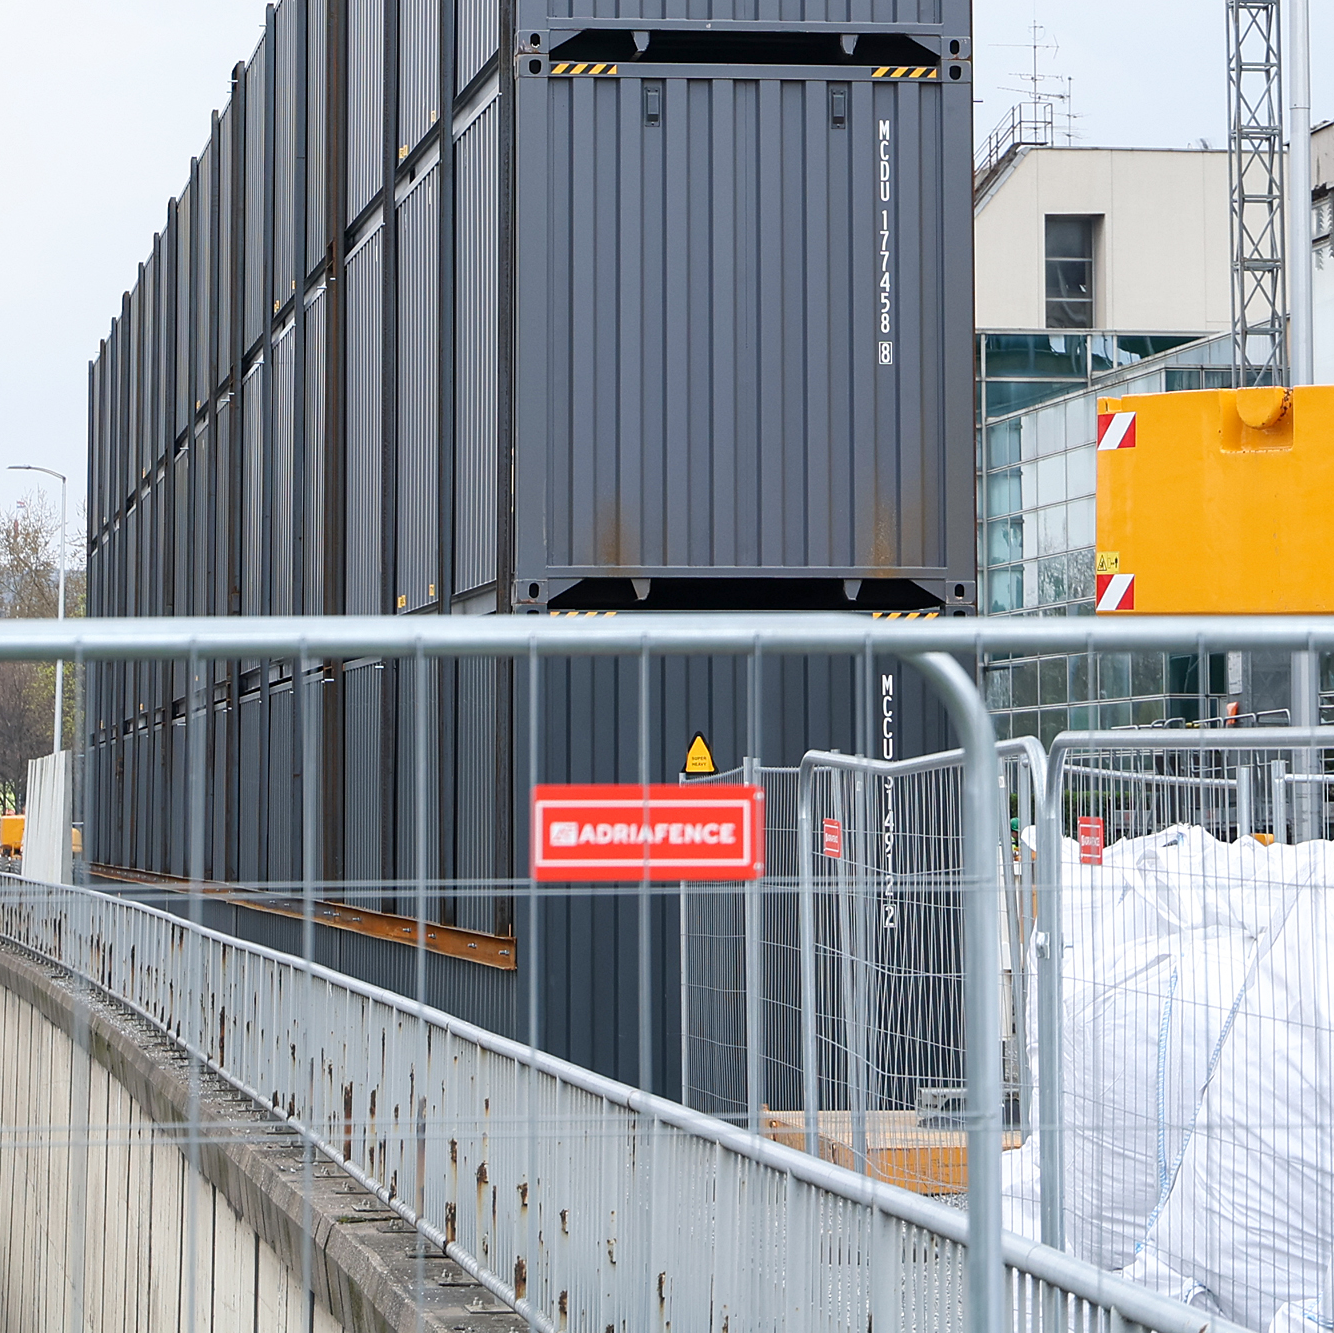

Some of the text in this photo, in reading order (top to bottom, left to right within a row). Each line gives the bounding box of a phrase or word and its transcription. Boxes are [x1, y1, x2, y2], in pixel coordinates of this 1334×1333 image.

[878, 119, 891, 363] MCDU 177458 8
[881, 674, 894, 760] MCCU
[576, 822, 736, 845] ADRIAFENCE
